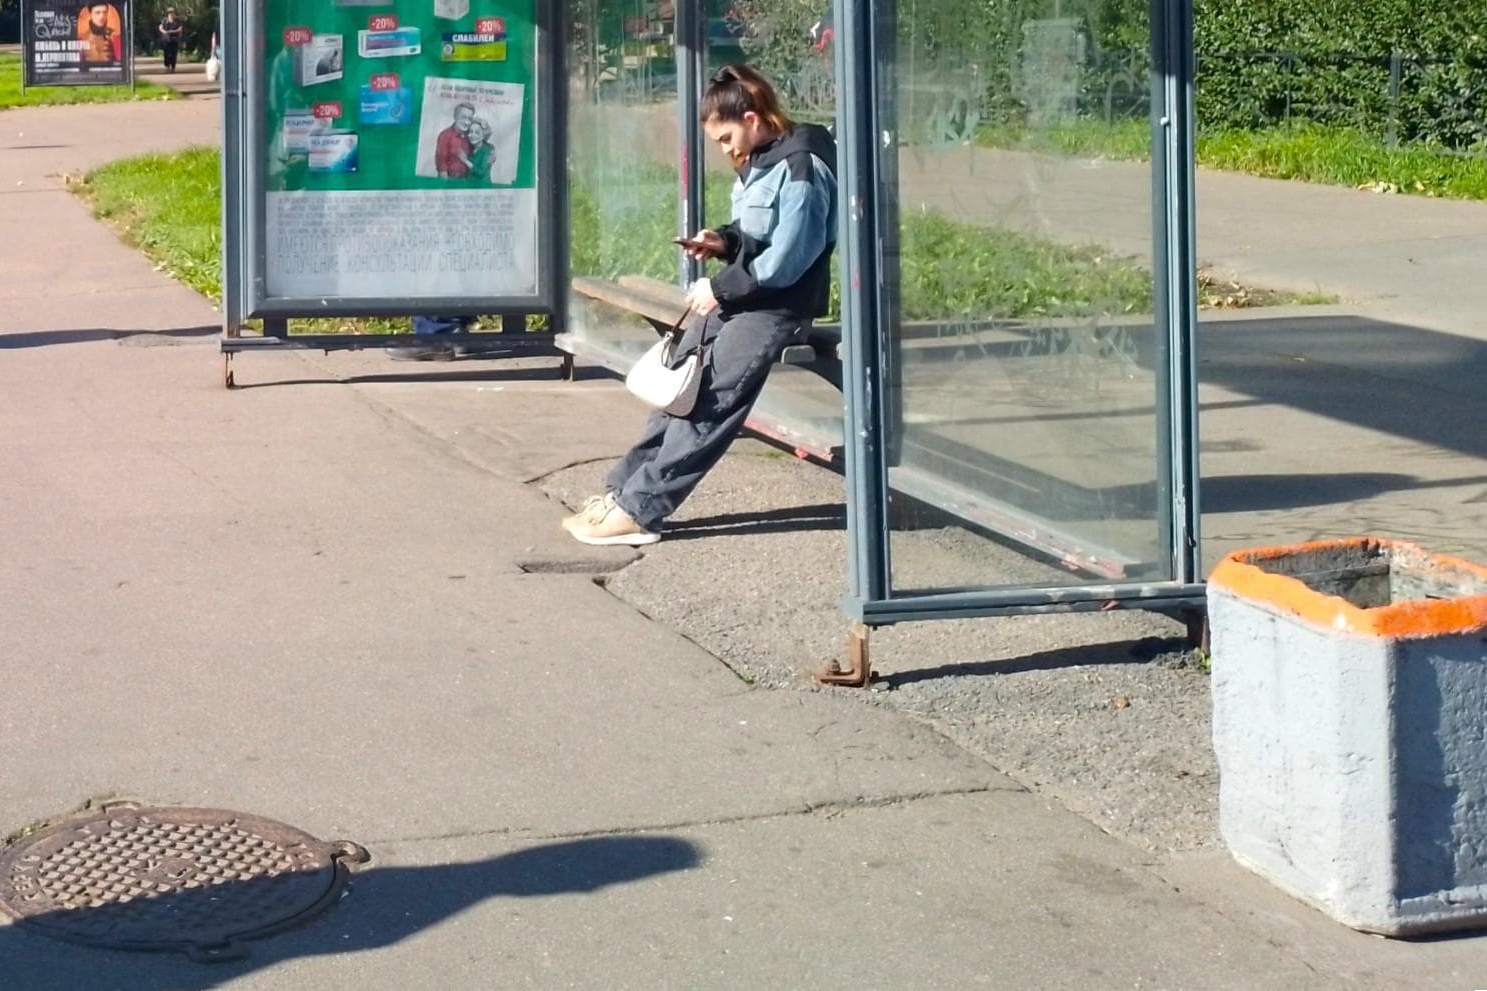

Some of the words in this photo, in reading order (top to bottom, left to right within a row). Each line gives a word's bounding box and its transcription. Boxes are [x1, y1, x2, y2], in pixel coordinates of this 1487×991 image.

[371, 17, 395, 30] -20%
[478, 19, 502, 33] -20%
[285, 29, 309, 42] -20%
[373, 76, 397, 89] -20%
[315, 104, 339, 117] -20%
